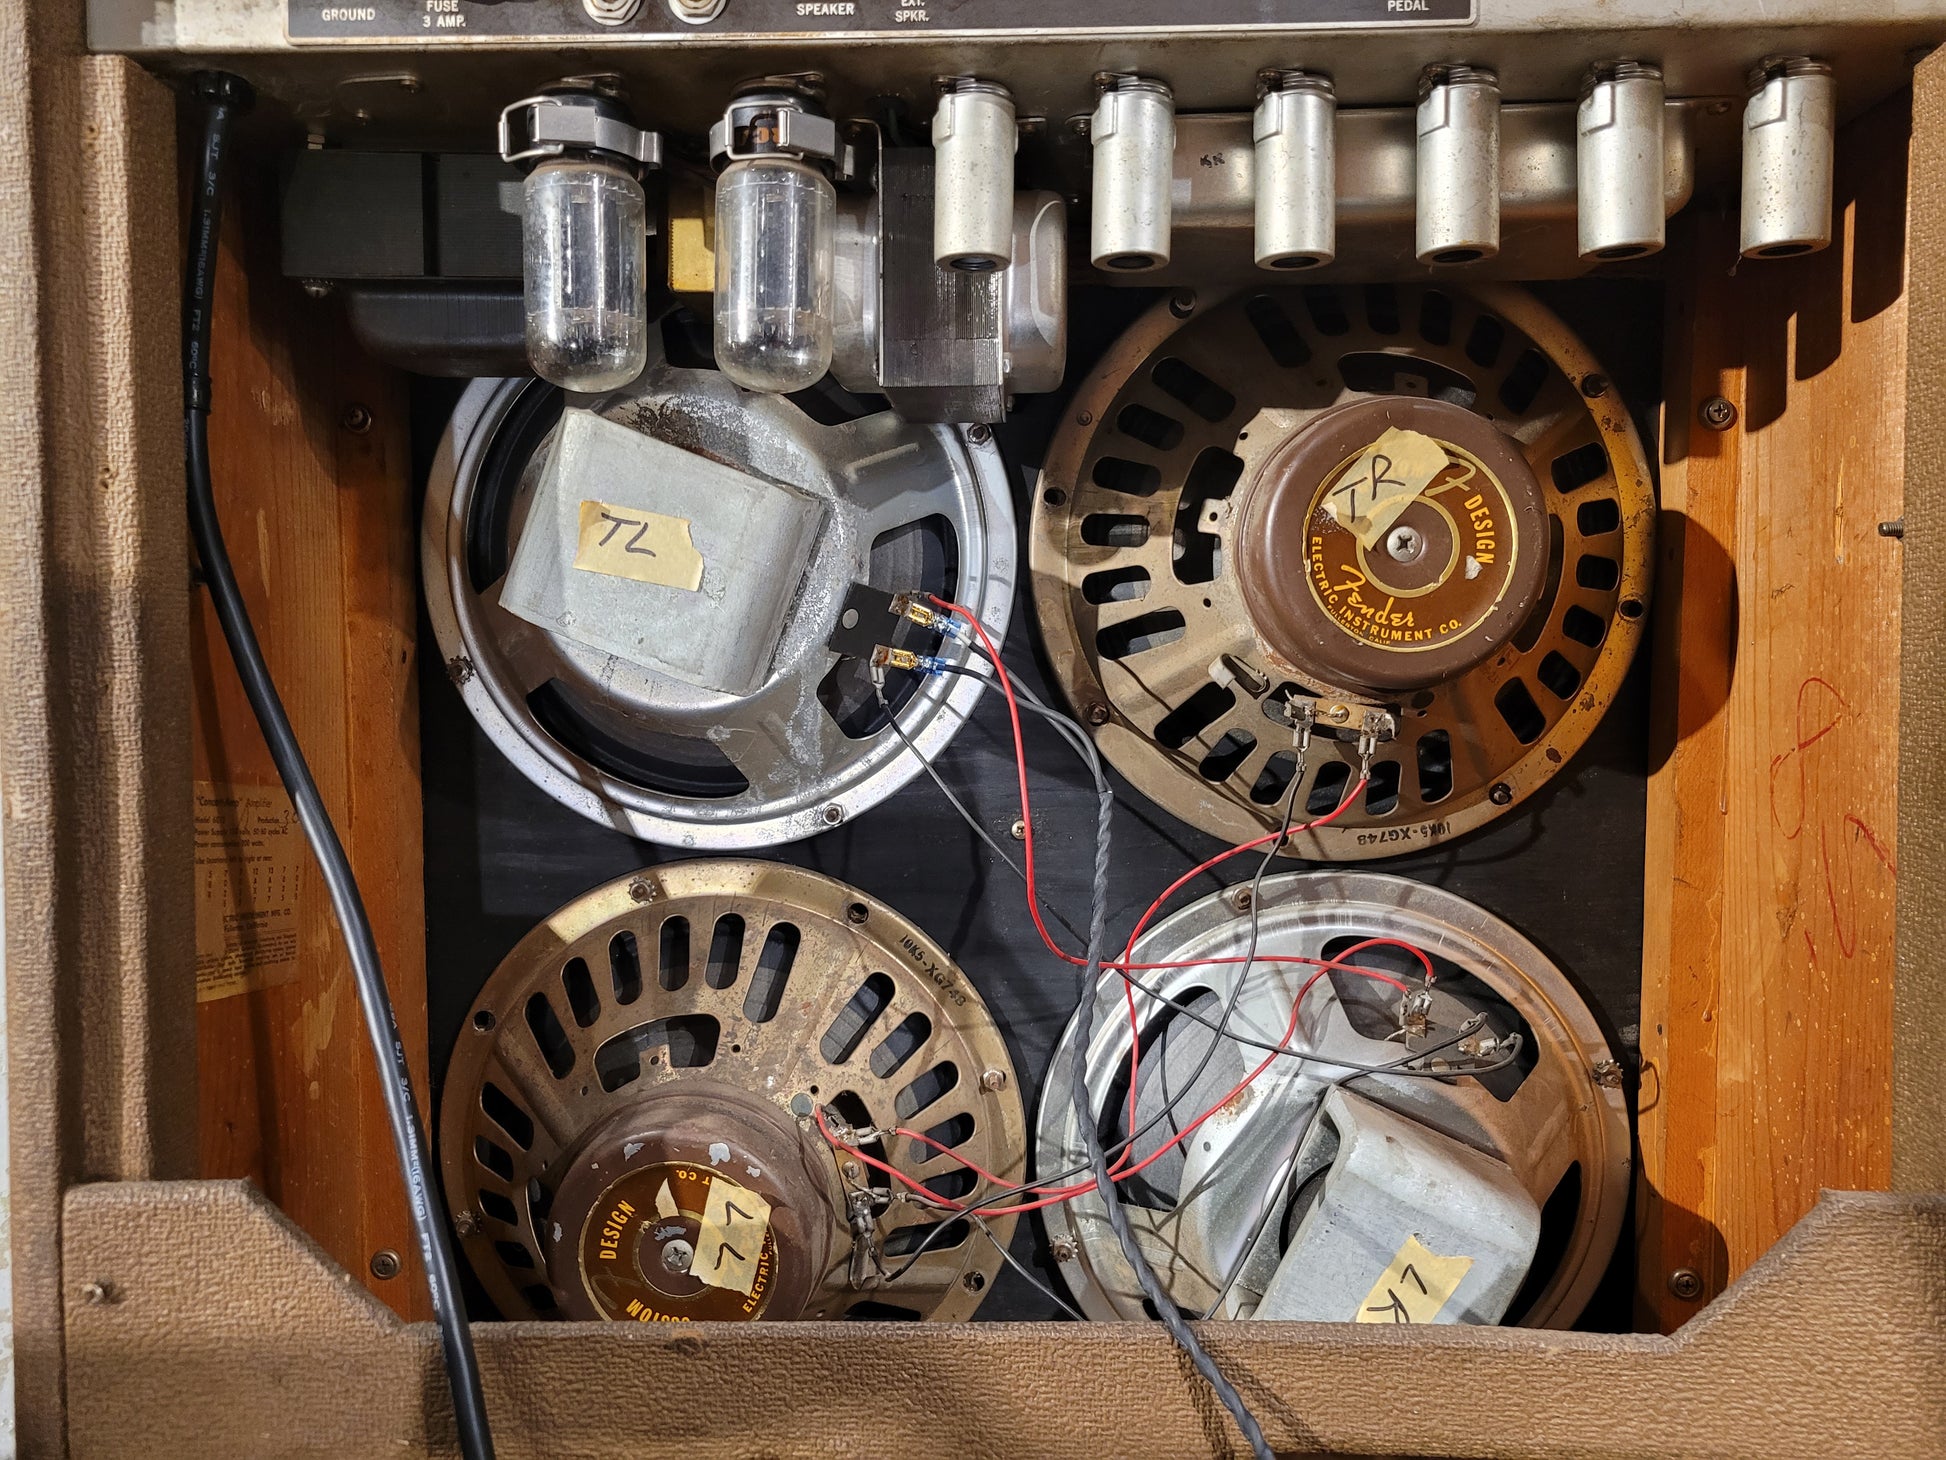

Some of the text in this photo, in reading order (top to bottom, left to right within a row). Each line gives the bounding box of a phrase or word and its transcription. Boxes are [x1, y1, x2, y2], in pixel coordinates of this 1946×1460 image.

[321, 7, 376, 21] GROUND
[422, 14, 466, 28] 3 AMP.
[426, 0, 459, 12] FUSE
[796, 3, 855, 16] SPEAKER
[895, 10, 930, 23] SPKR.
[1387, 0, 1430, 12] PEDAL
[1332, 453, 1406, 524] TR
[598, 511, 657, 558] TL
[1463, 493, 1495, 565] DESIGN
[1311, 536, 1462, 642] ELECTRIC INSTRUMENT CO.
[1333, 564, 1416, 628] Fender
[599, 1200, 636, 1260] DESIGN
